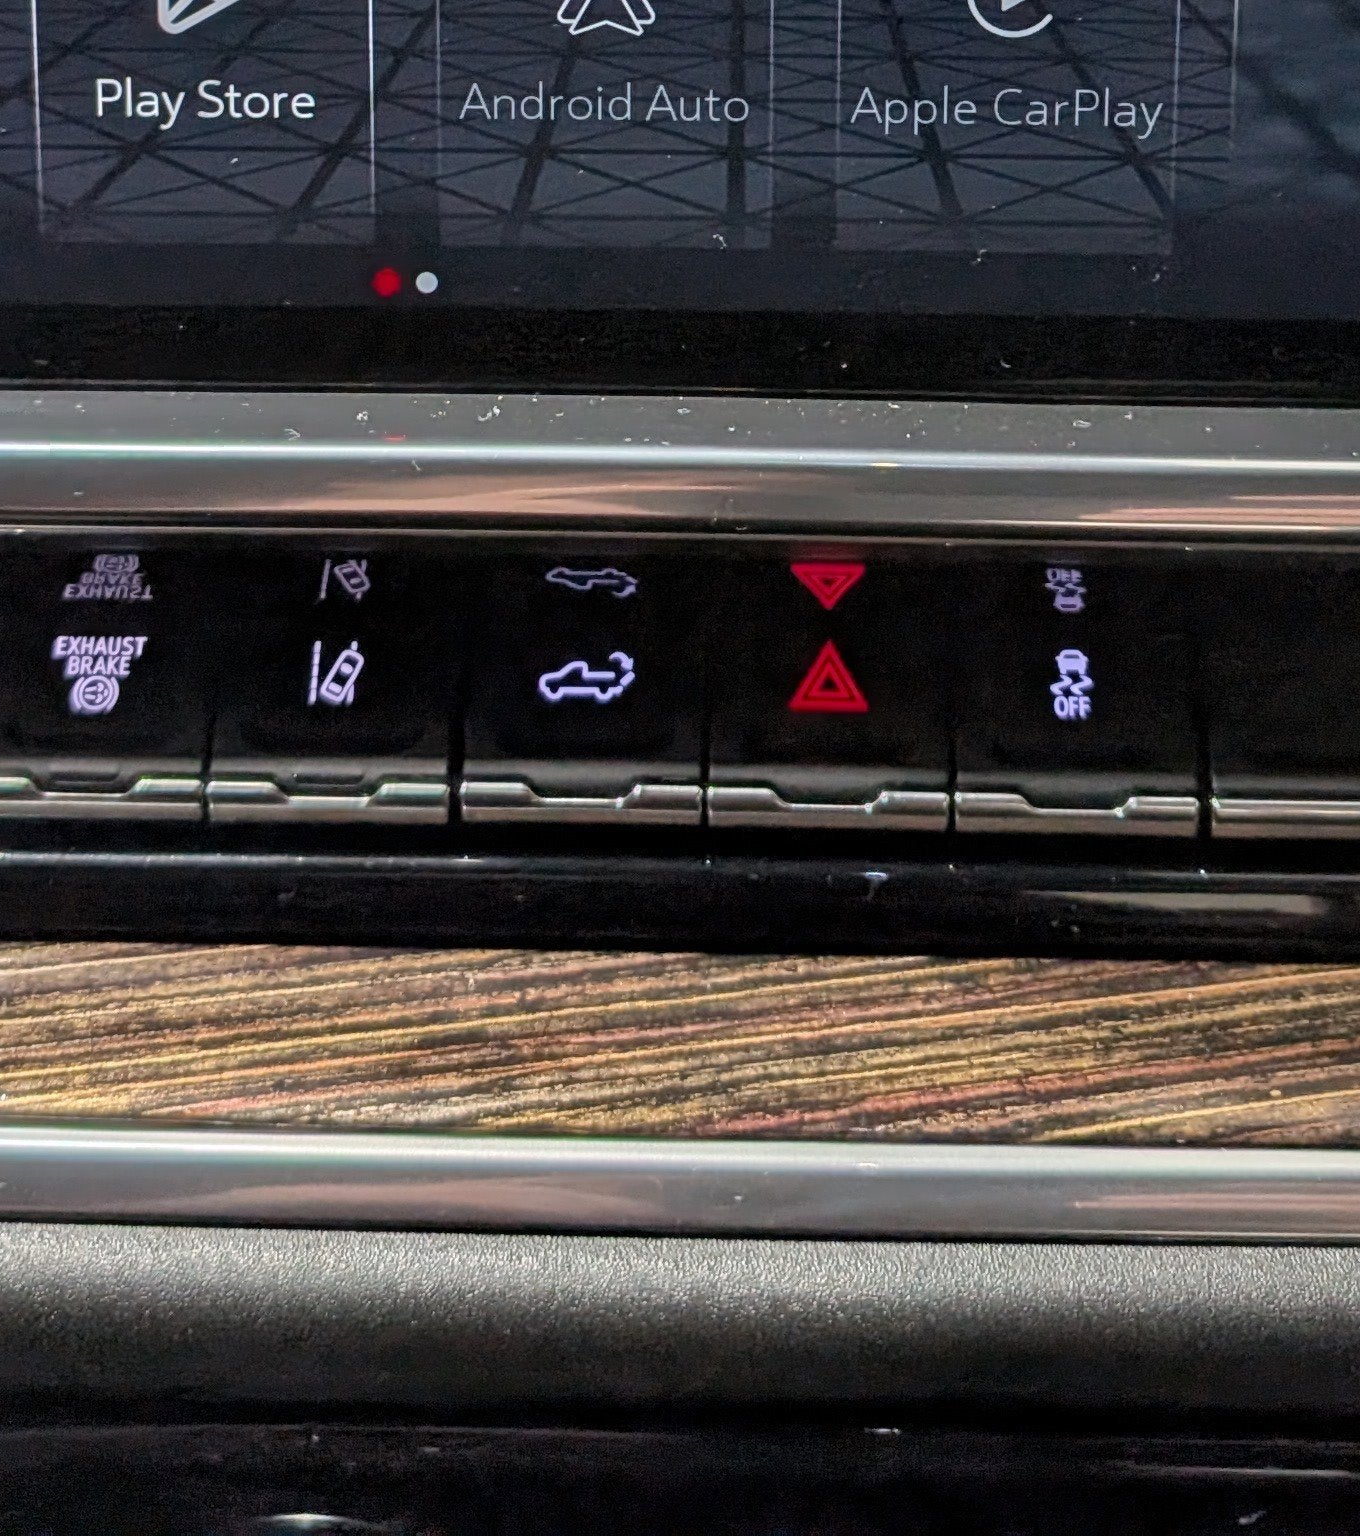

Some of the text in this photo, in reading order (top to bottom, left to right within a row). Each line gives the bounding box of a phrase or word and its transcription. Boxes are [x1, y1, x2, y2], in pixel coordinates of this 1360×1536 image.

[95, 77, 317, 130] Play Store
[458, 81, 750, 123] Android Auto
[850, 86, 1164, 140] Apple CarPlay
[52, 635, 149, 657] EXHAUST
[64, 655, 132, 677] BRAKE
[1053, 695, 1091, 720] OFF
